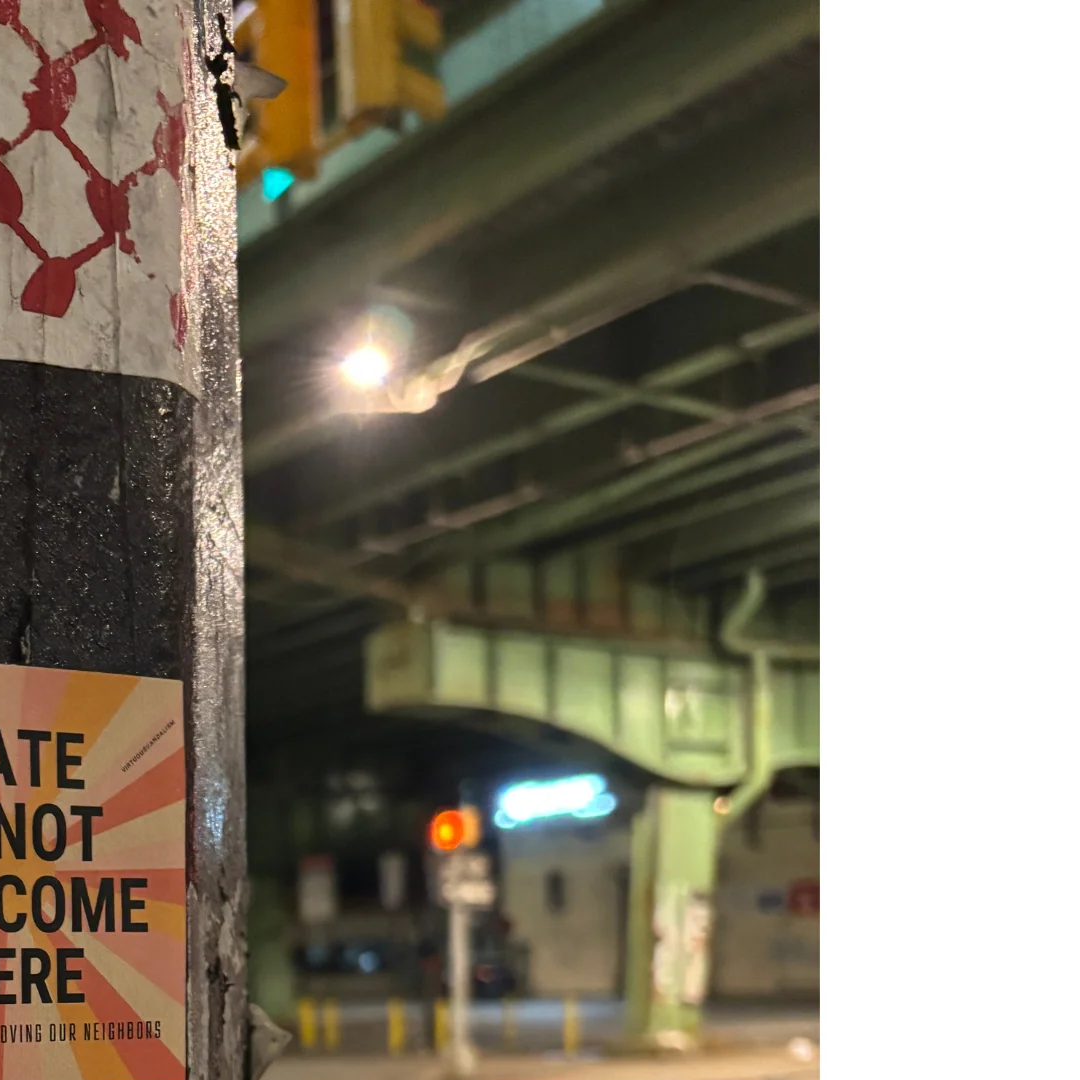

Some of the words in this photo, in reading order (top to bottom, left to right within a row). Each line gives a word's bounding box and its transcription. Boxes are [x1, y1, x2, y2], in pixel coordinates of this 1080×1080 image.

[121, 719, 176, 773] VIRTUOUSVANDALISM
[49, 1022, 77, 1042] OUR
[83, 1020, 162, 1041] NEIGHBORS
